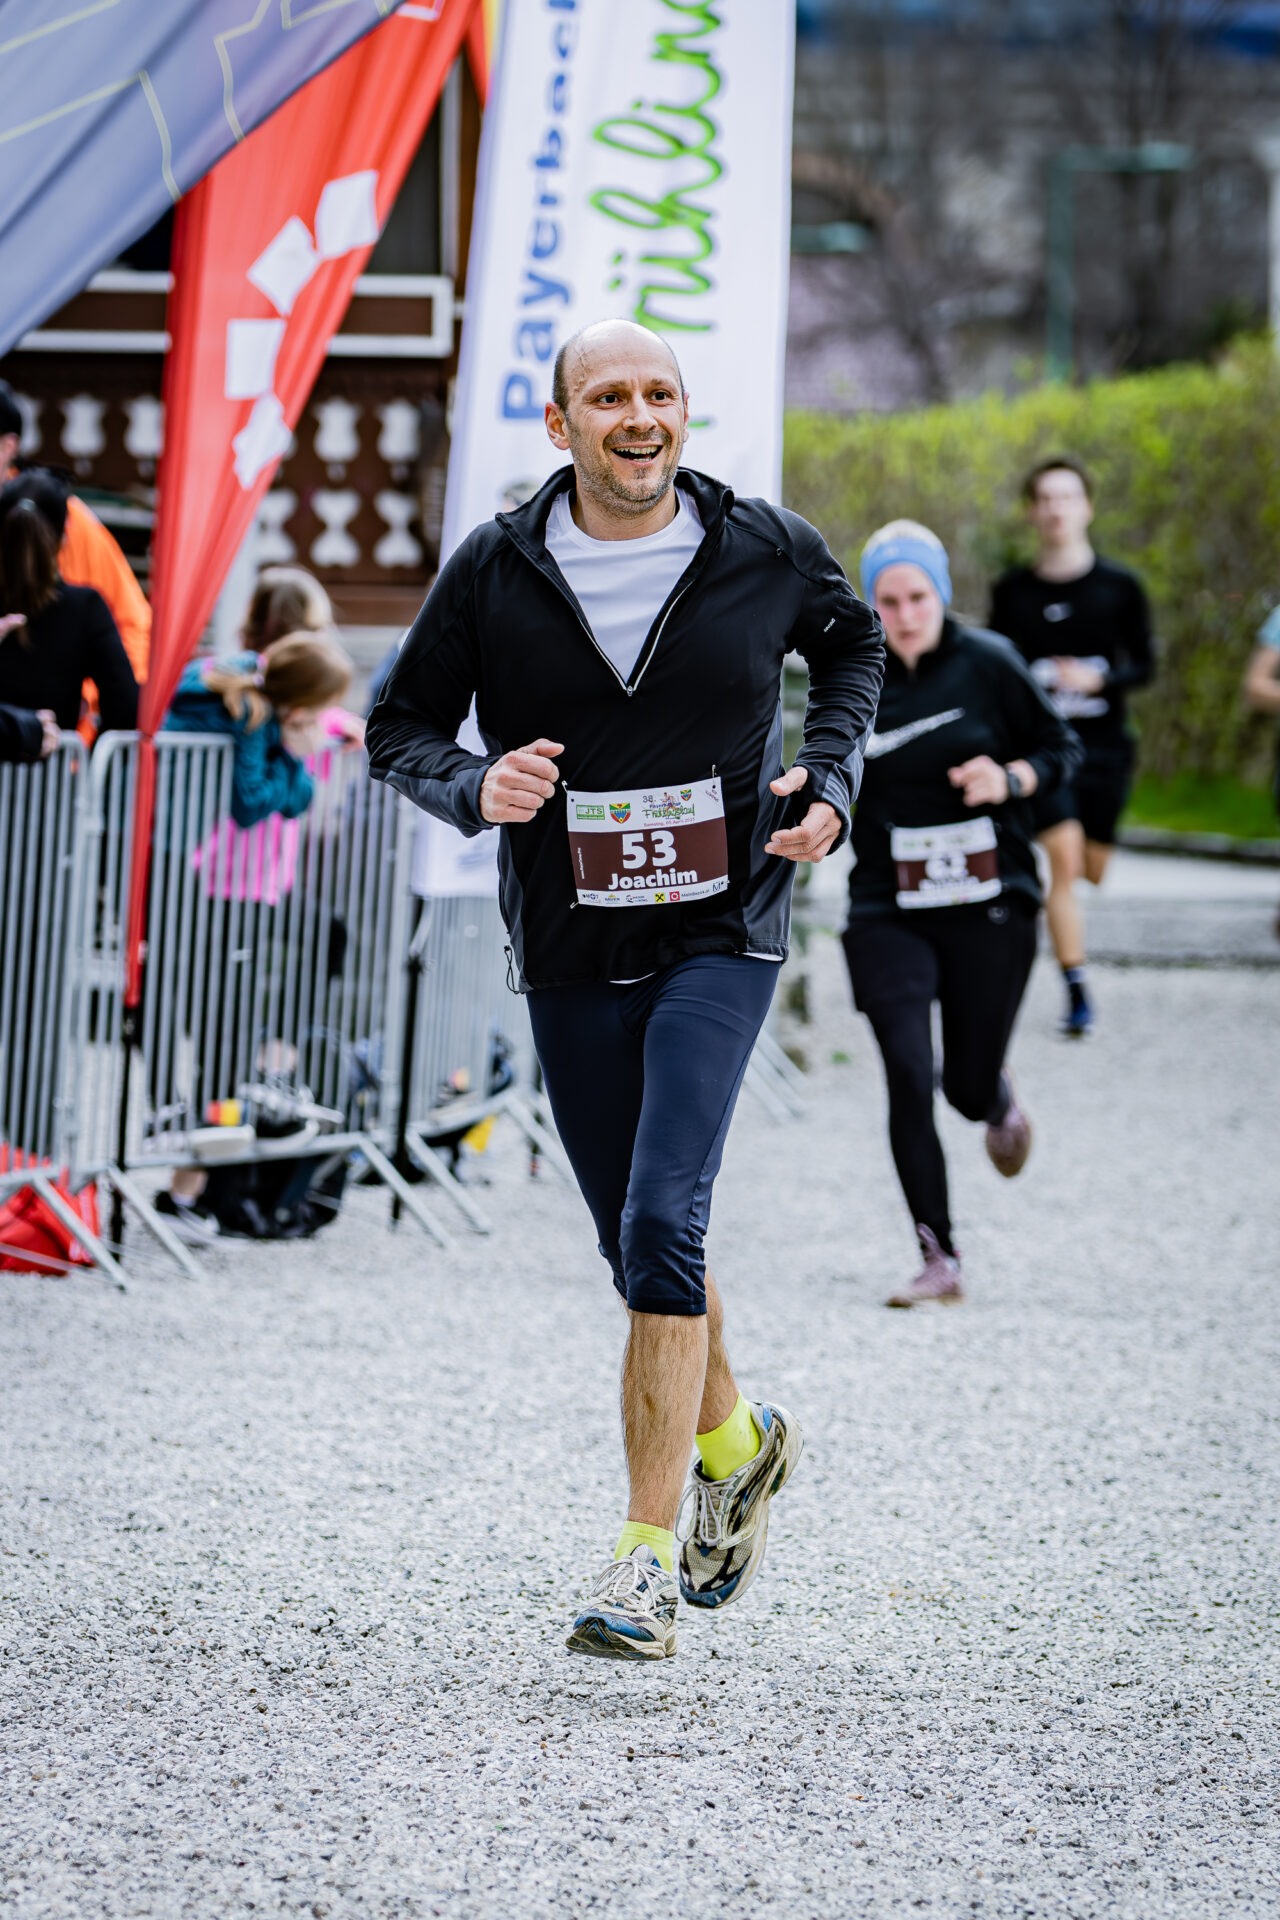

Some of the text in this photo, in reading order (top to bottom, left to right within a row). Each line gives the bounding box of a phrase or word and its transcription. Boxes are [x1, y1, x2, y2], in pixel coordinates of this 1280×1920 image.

[585, 807, 602, 815] JTS
[622, 830, 677, 870] 53
[608, 868, 698, 890] Joachim
